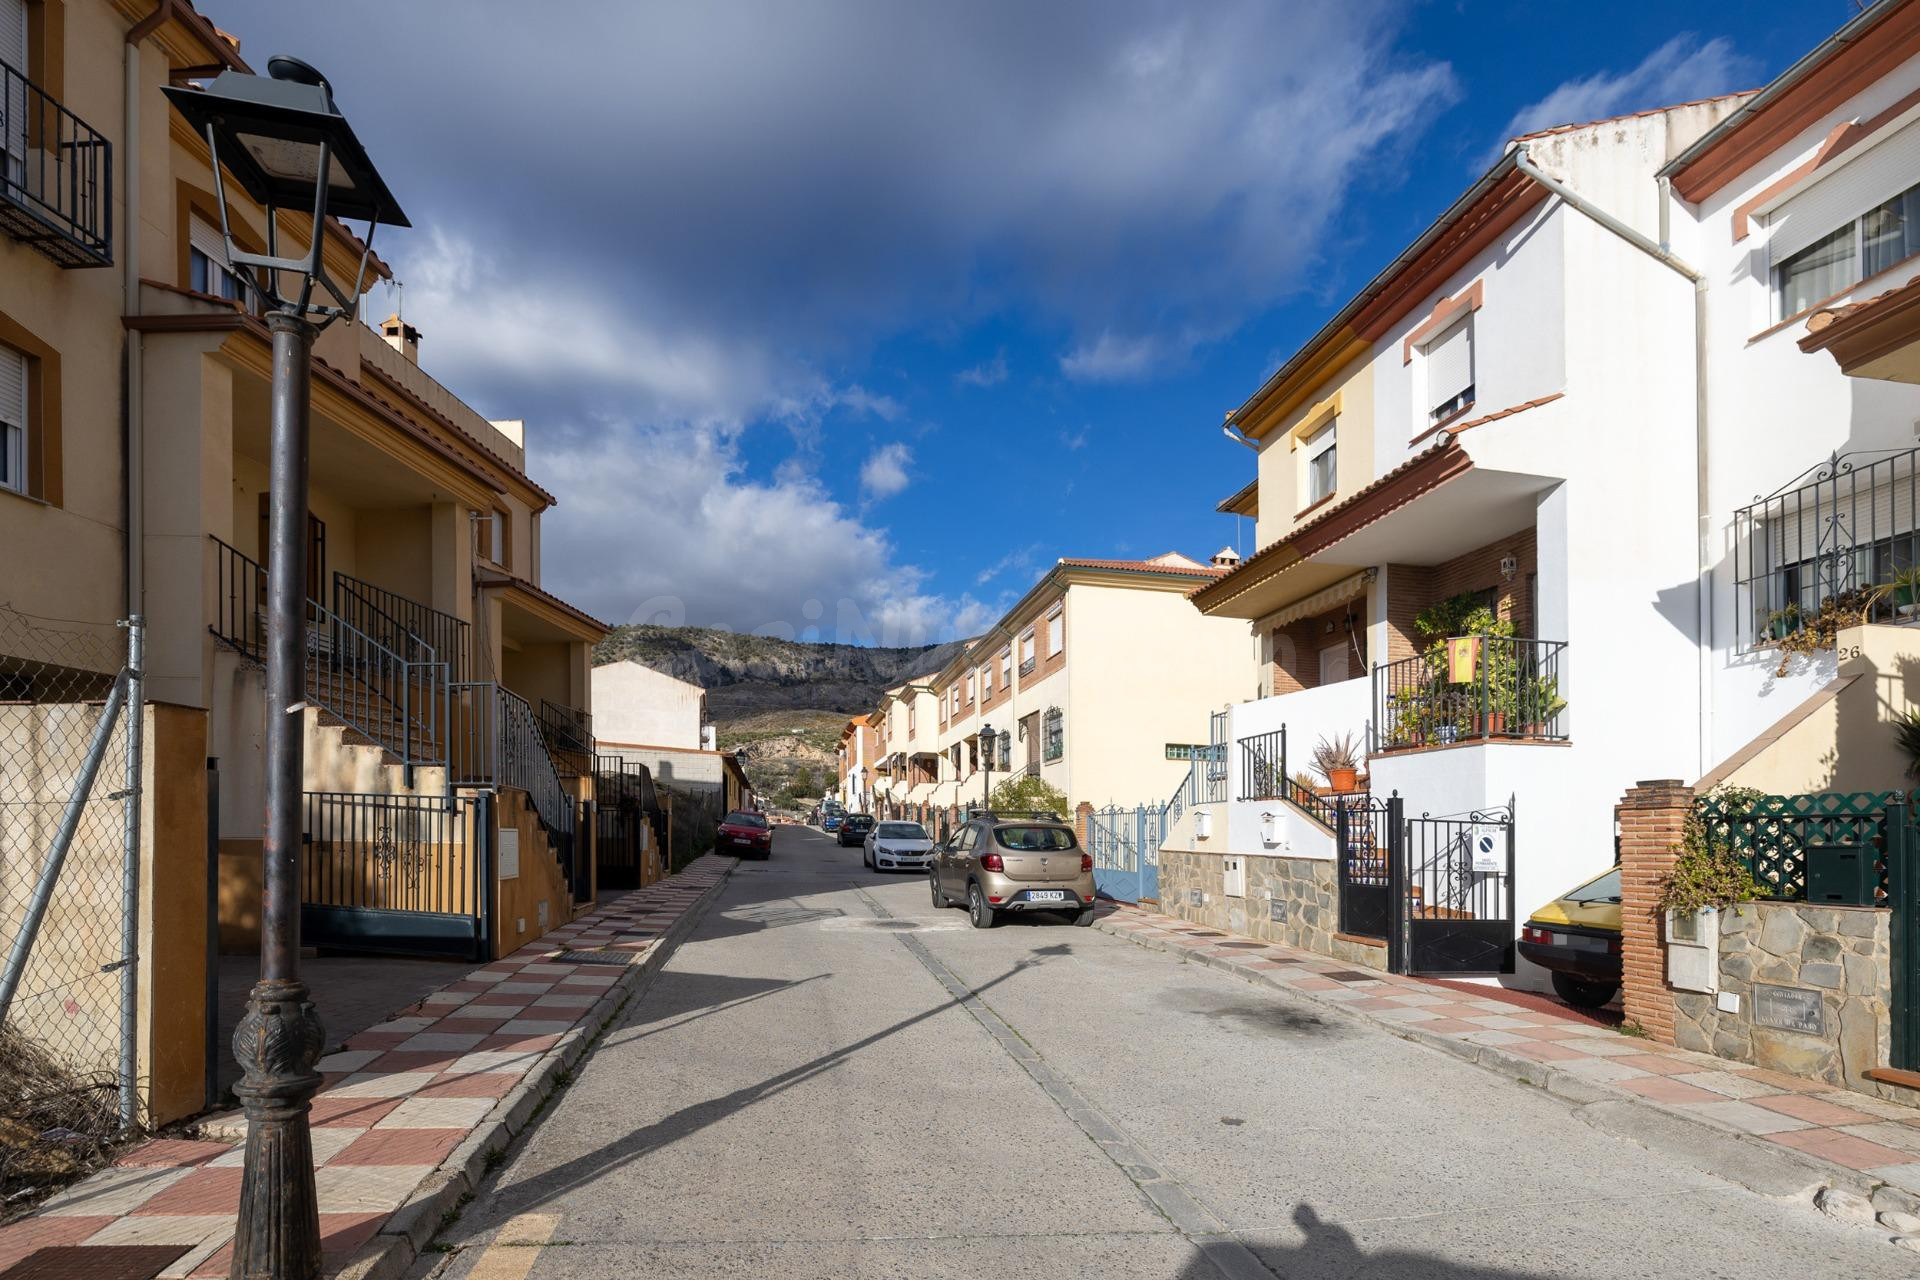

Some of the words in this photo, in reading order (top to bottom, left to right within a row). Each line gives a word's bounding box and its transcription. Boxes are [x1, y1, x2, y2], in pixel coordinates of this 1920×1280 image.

[1838, 645, 1860, 661] 26
[1031, 891, 1048, 899] 2849
[1798, 1021, 1817, 1031] PASO
